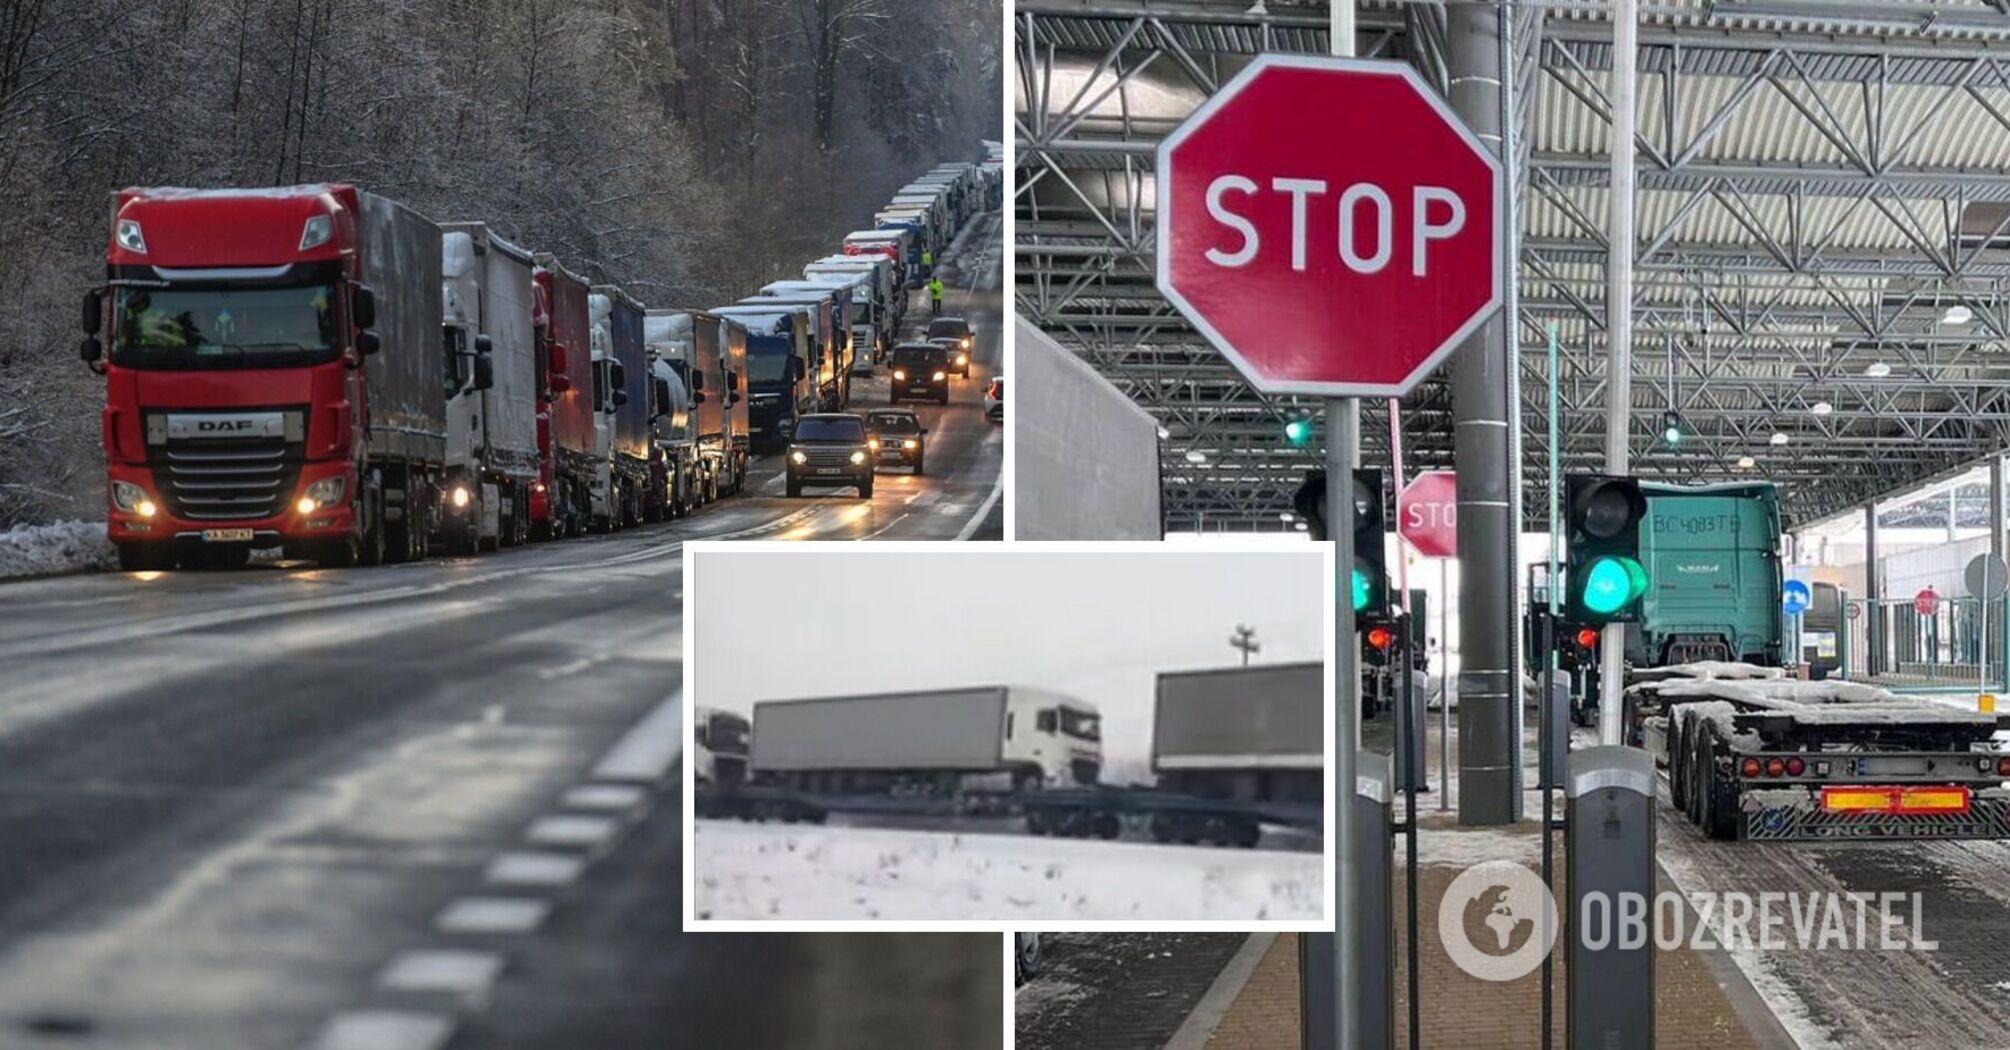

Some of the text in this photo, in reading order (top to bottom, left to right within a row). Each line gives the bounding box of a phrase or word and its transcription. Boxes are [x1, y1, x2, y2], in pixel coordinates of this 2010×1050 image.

[1204, 174, 1467, 277] STOP
[198, 420, 253, 431] DAF
[1801, 825, 1989, 837] LONG VEHICLE
